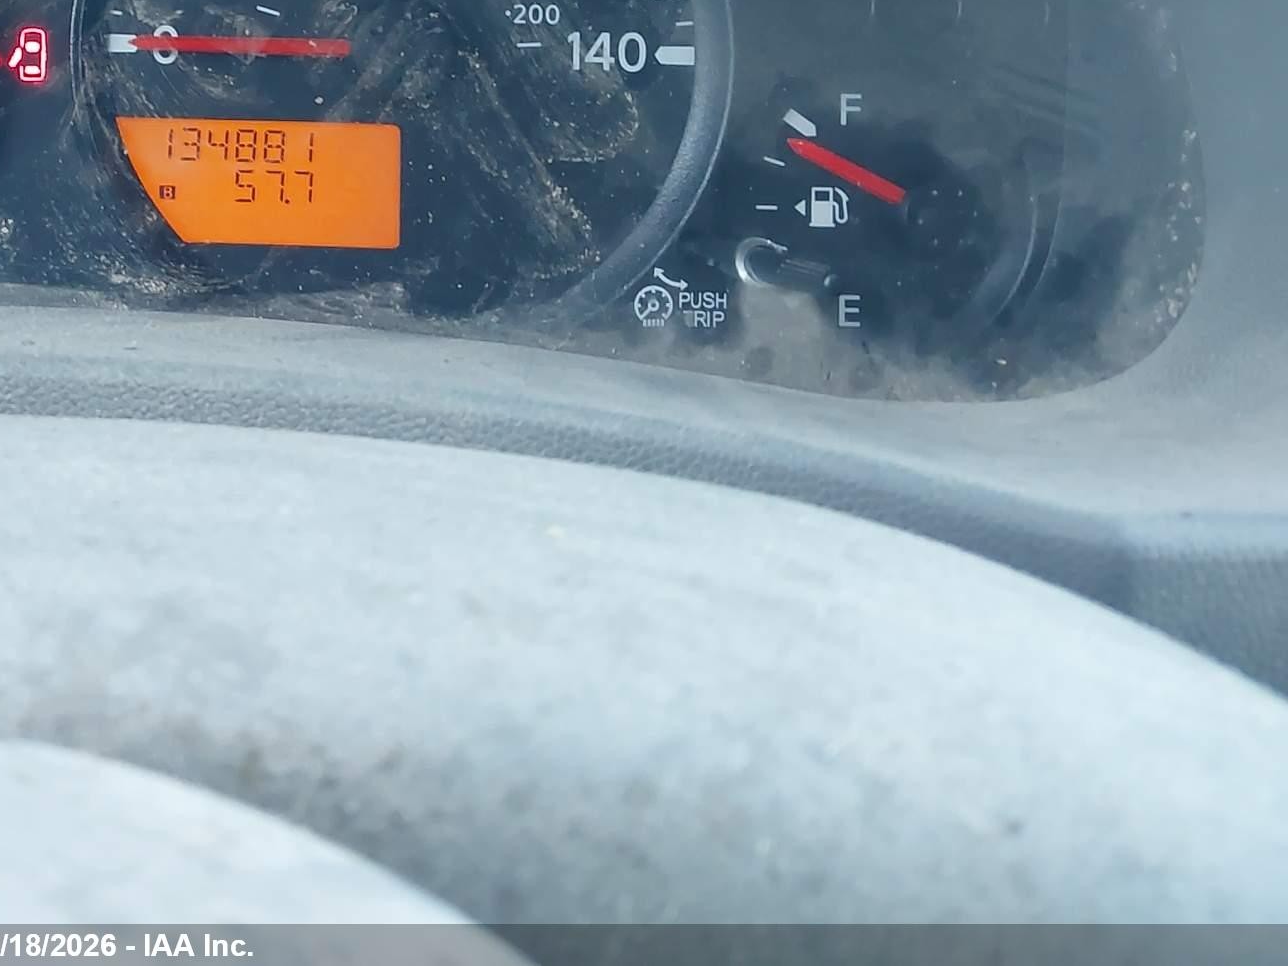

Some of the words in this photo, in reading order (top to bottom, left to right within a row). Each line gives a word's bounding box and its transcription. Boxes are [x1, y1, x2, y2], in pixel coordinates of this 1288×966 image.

[513, 5, 560, 25] 200
[152, 26, 179, 65] 0
[567, 32, 647, 72] 140
[840, 93, 862, 125] F
[166, 128, 315, 163] 134881
[235, 170, 315, 203] 57.7
[679, 292, 727, 309] PUSH
[839, 294, 861, 327] E
